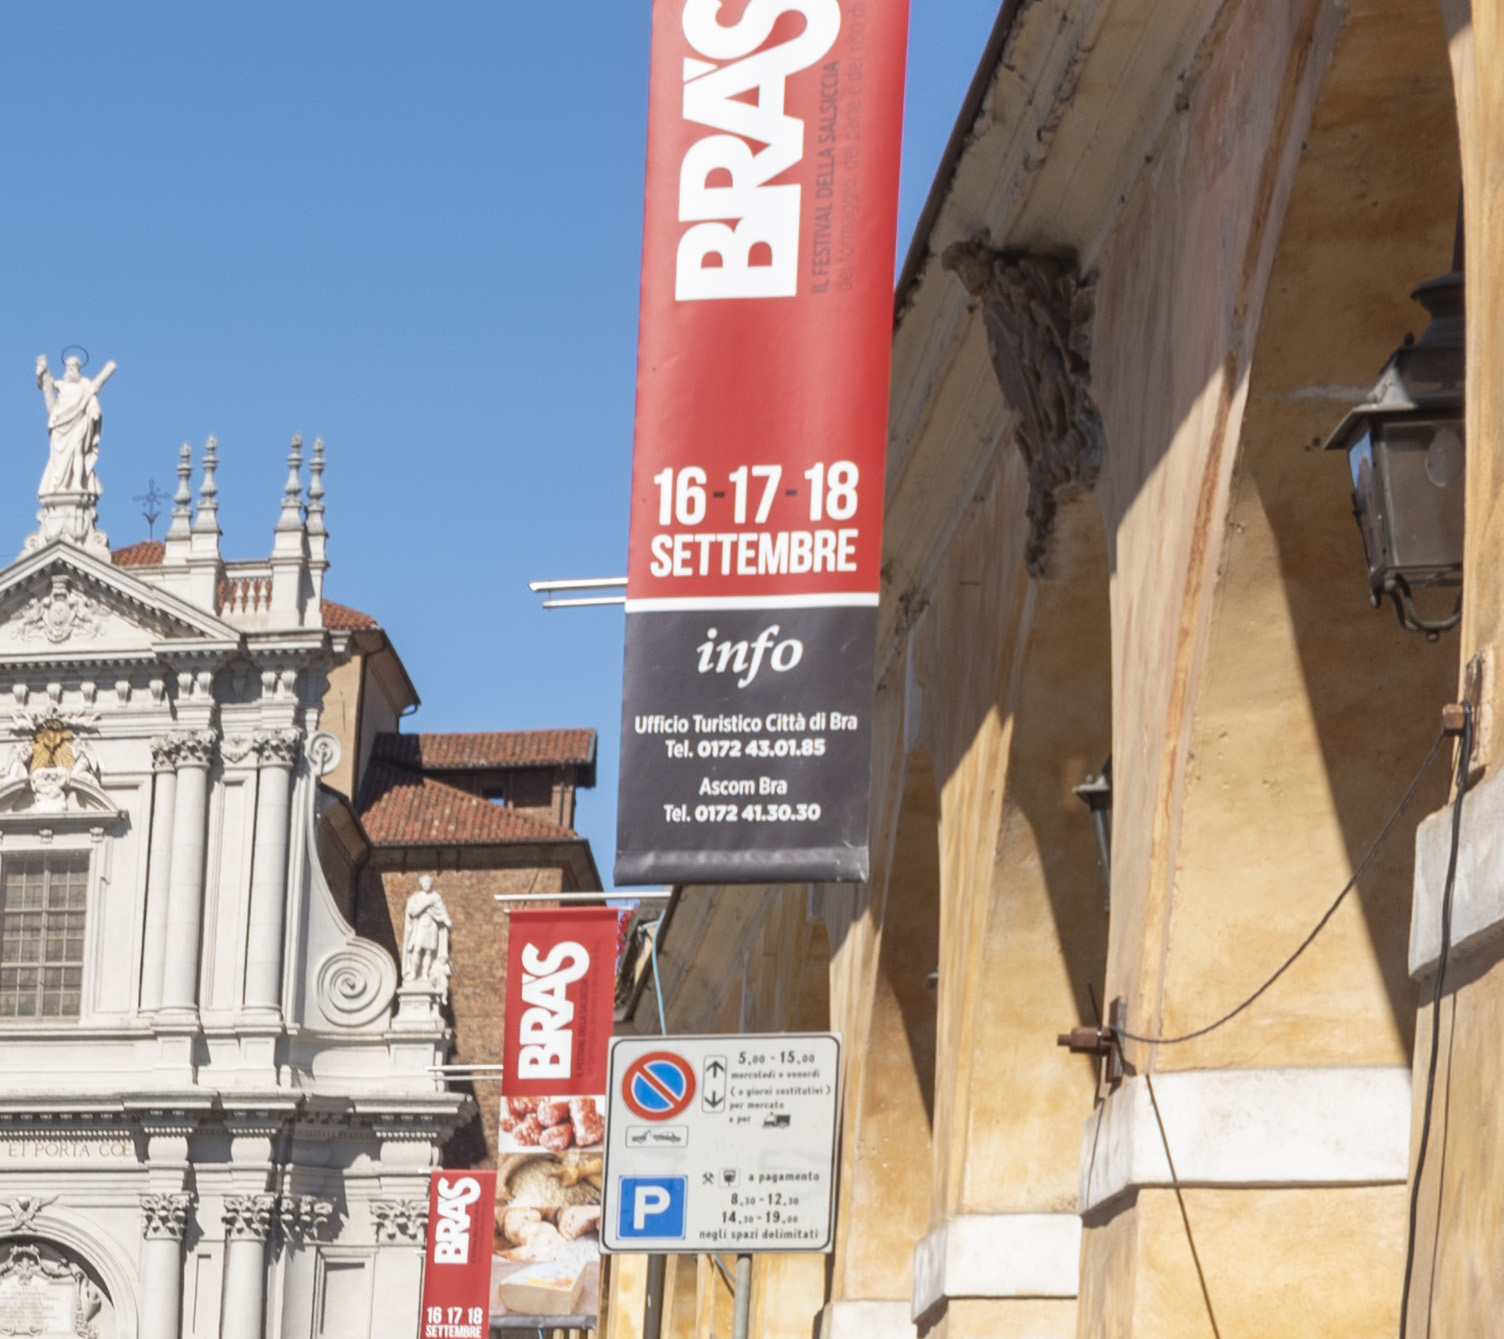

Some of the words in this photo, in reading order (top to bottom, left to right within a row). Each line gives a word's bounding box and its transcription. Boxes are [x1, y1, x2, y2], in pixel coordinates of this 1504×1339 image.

[818, 60, 840, 146] SALSICCIA
[845, 105, 863, 144] pane
[814, 147, 837, 199] DELLA
[812, 210, 834, 277] FESTIVAL
[812, 281, 829, 295] IL
[650, 529, 859, 578] SETTEMBRE
[696, 624, 804, 689] info
[634, 715, 689, 734] Ufficio
[693, 713, 762, 733] Turistico
[765, 712, 806, 732] Città
[809, 712, 825, 730] di
[830, 713, 858, 731] Bra
[665, 740, 694, 758] Tel.
[697, 740, 742, 758] 0172
[745, 738, 826, 757] 43.01.85
[699, 777, 755, 796] Ascom
[759, 777, 788, 795] Bra
[664, 804, 691, 823] Tel.
[695, 805, 739, 822] 0172
[741, 803, 822, 821] 41.30.30
[747, 1100, 785, 1110] mercato
[758, 1171, 820, 1184] pagamento
[633, 1186, 671, 1230] P
[699, 1228, 727, 1241] negli
[731, 1228, 759, 1242] spazi
[761, 1228, 819, 1240] delimitati
[425, 1324, 482, 1339] SETTEMBRE
